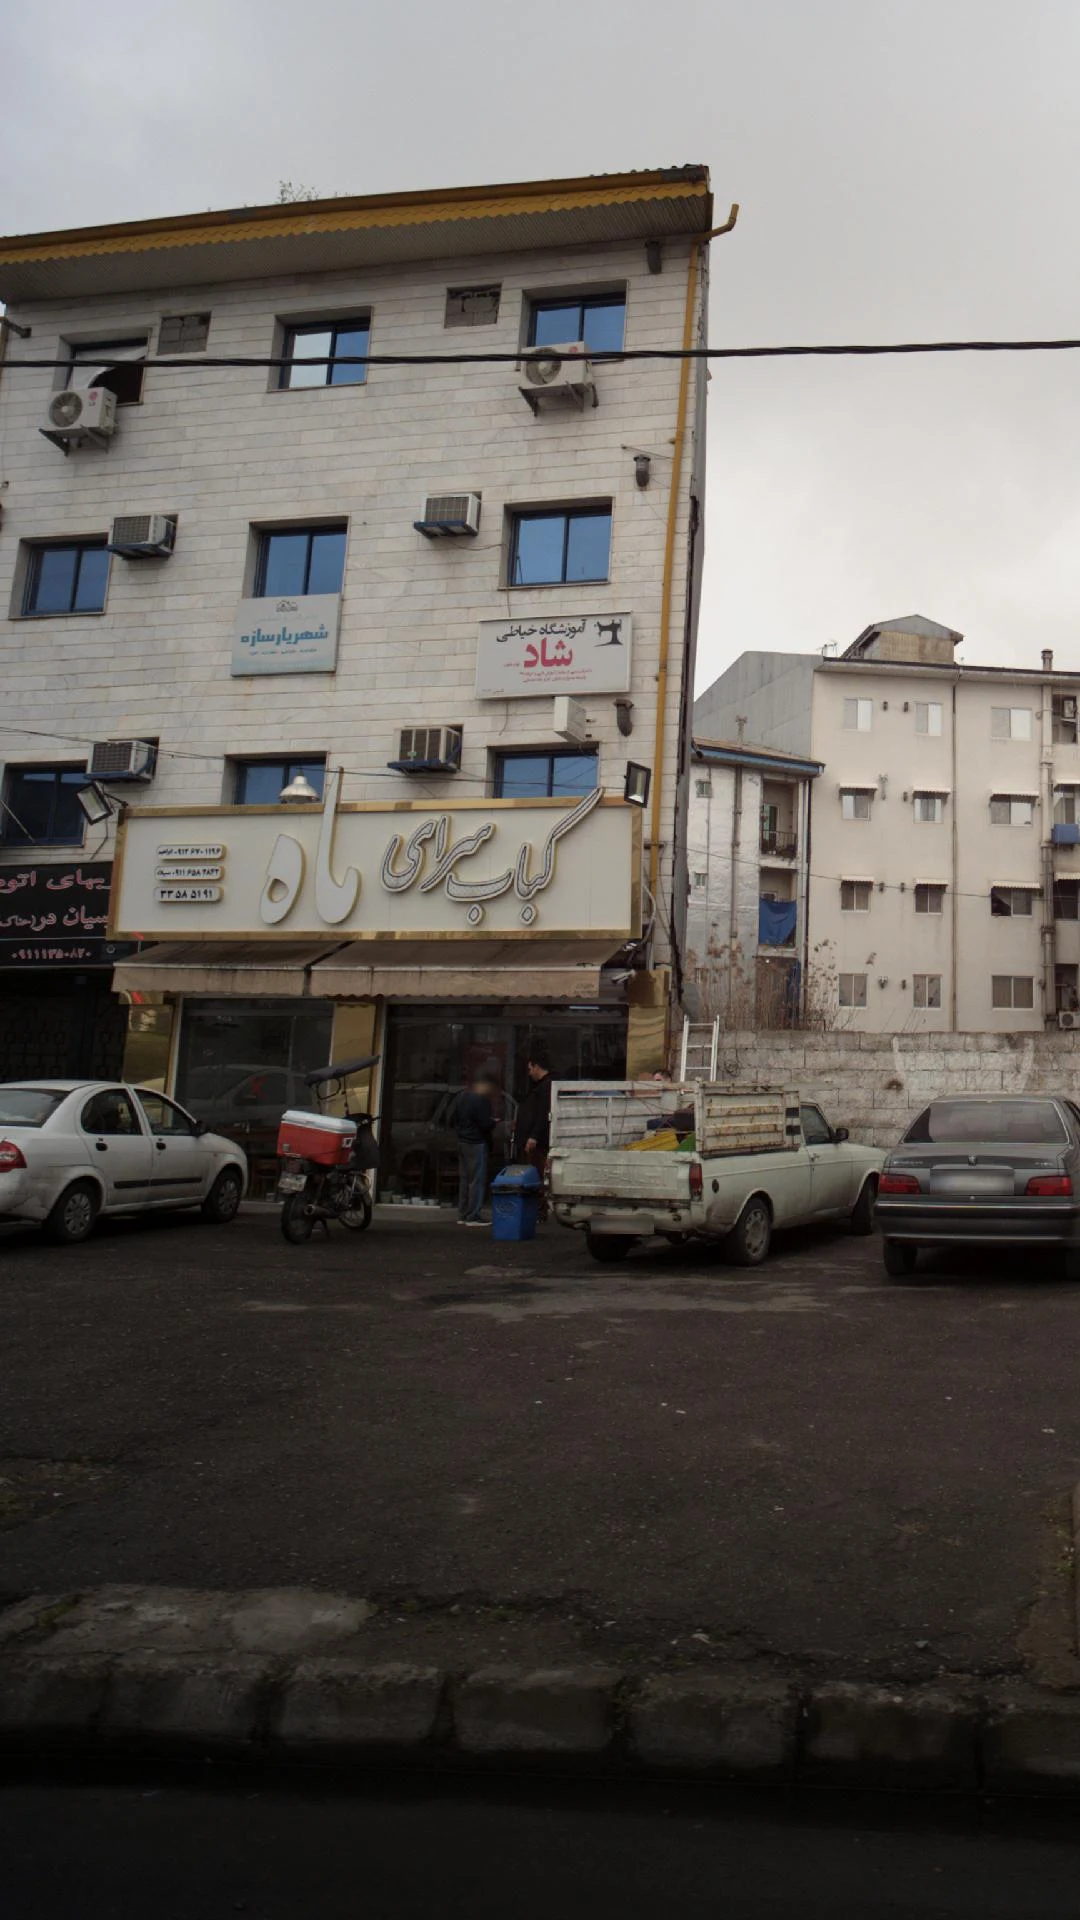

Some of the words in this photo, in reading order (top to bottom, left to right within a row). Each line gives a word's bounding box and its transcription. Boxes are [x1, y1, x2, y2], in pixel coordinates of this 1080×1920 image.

[496, 624, 537, 643] خیاطی
[523, 637, 573, 669] شاد
[539, 619, 587, 639] آموزشگاه
[259, 765, 362, 925] ماه
[381, 814, 497, 893] سرای
[445, 786, 604, 926] کباب
